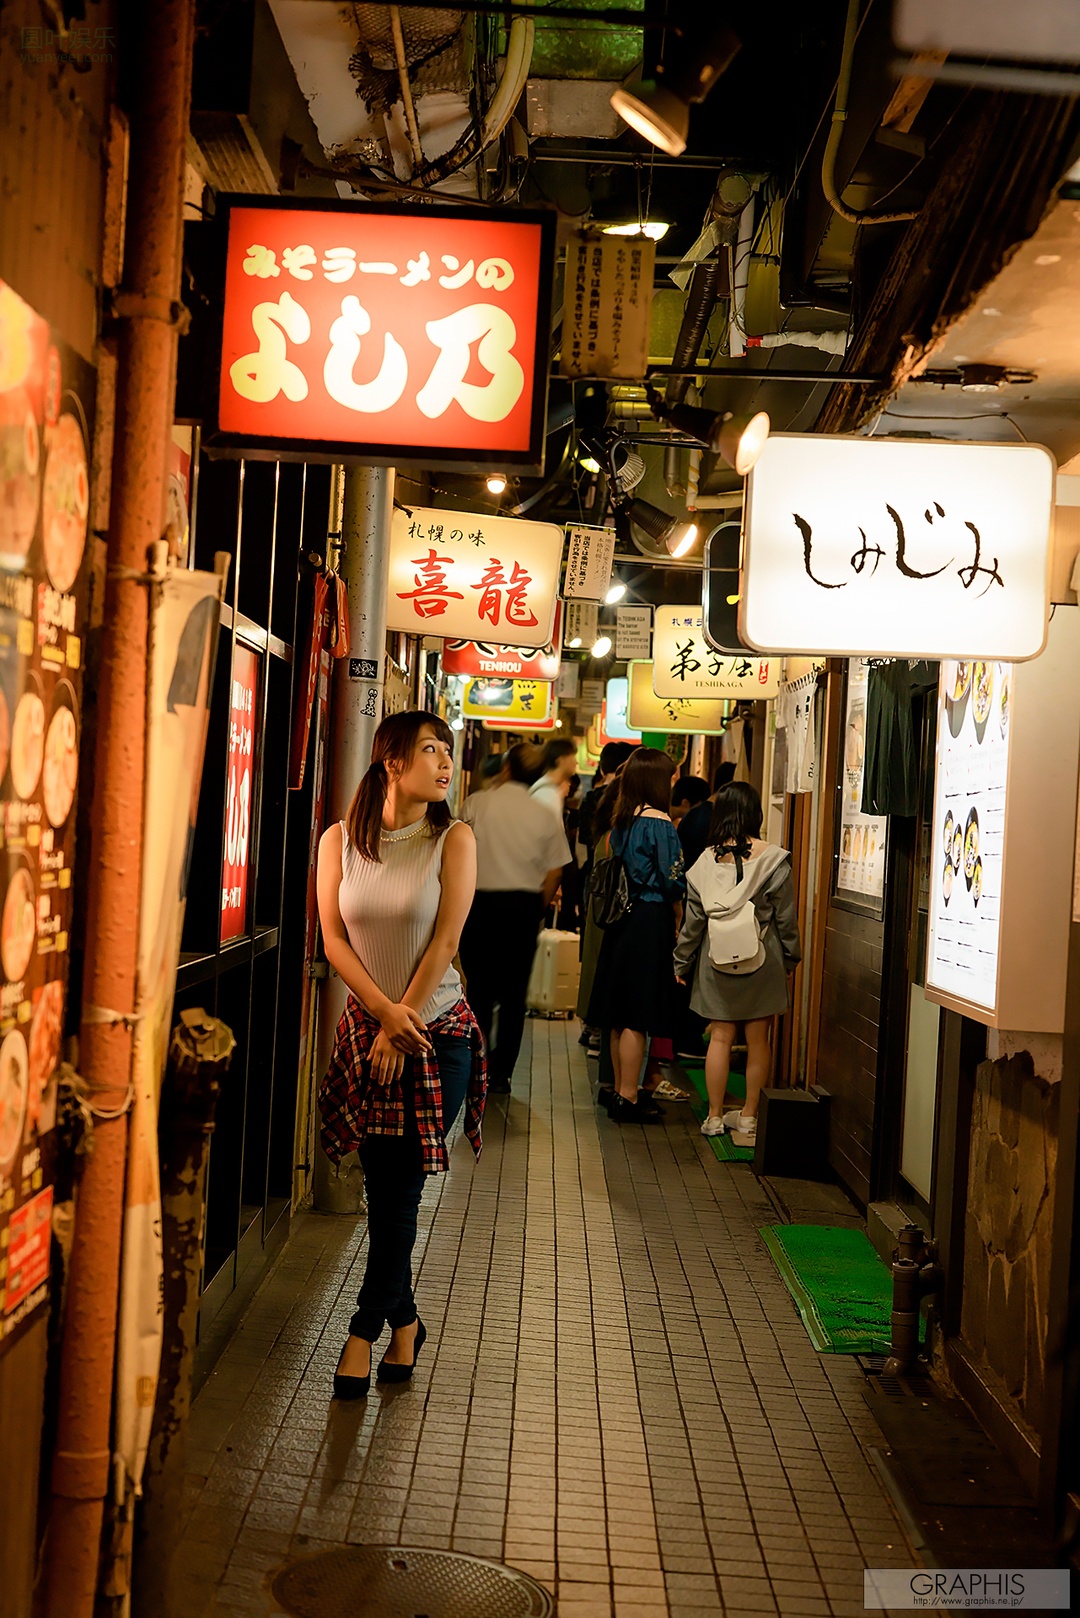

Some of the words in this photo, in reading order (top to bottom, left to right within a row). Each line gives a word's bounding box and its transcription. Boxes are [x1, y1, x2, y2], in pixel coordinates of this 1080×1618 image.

[241, 243, 516, 292] みそラーメンの
[228, 290, 525, 424] よし乃
[408, 521, 487, 547] 札幌の味
[792, 501, 1005, 600] しみじみ
[396, 548, 539, 627] 喜龍
[479, 660, 522, 674] TENHOU
[695, 680, 744, 688] TESHIKAGA
[223, 765, 250, 867] し乃
